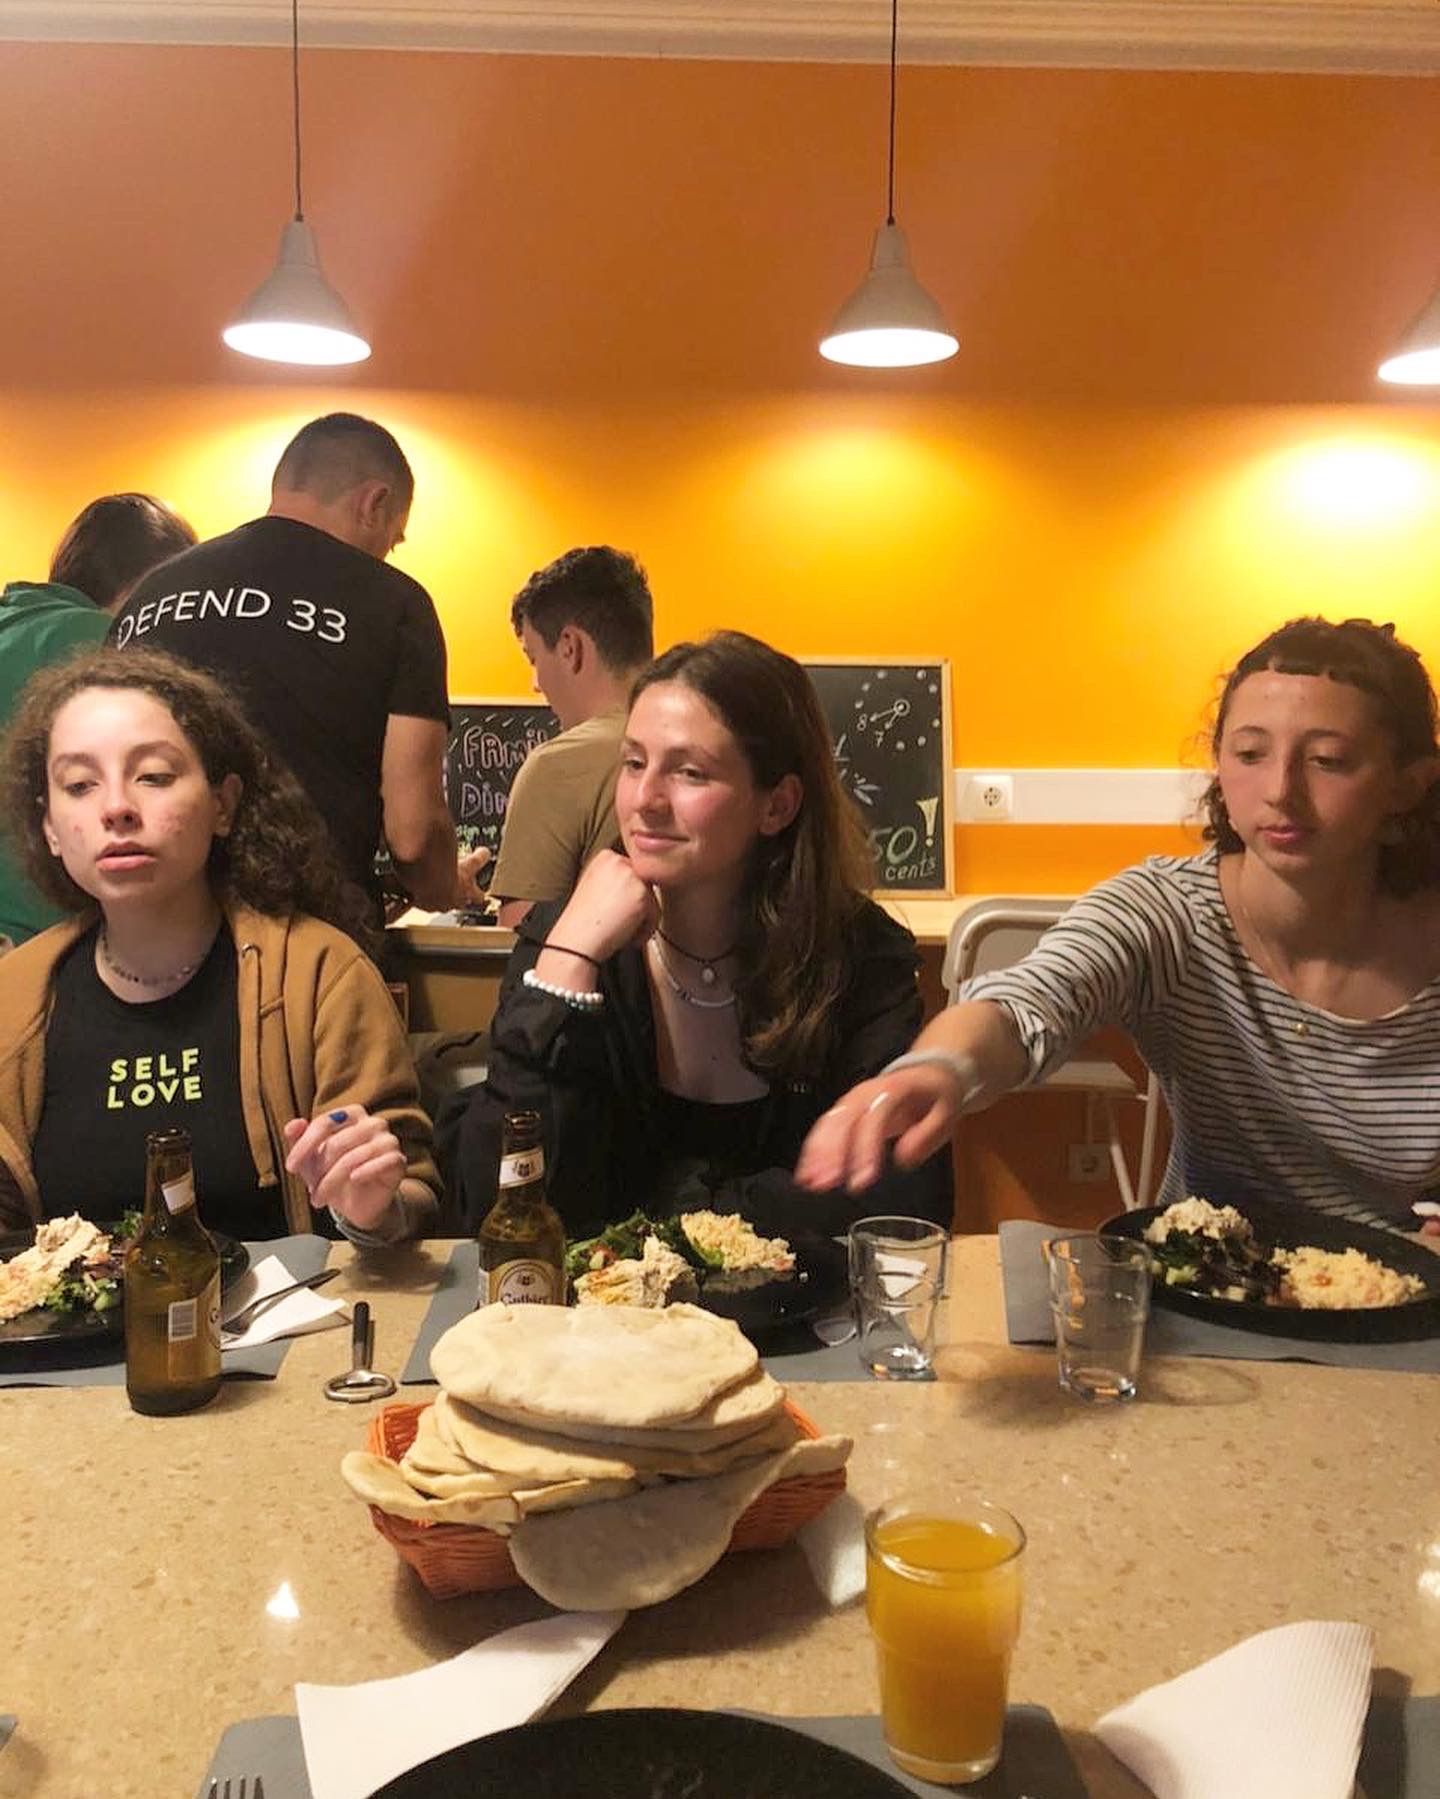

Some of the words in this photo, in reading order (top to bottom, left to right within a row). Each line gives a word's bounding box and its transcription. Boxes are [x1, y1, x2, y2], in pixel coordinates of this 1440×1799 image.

[117, 587, 271, 651] DEFEND
[286, 599, 348, 643] 33
[885, 852, 937, 881] cents
[110, 1047, 200, 1082] SELF
[107, 1075, 203, 1109] LOVE
